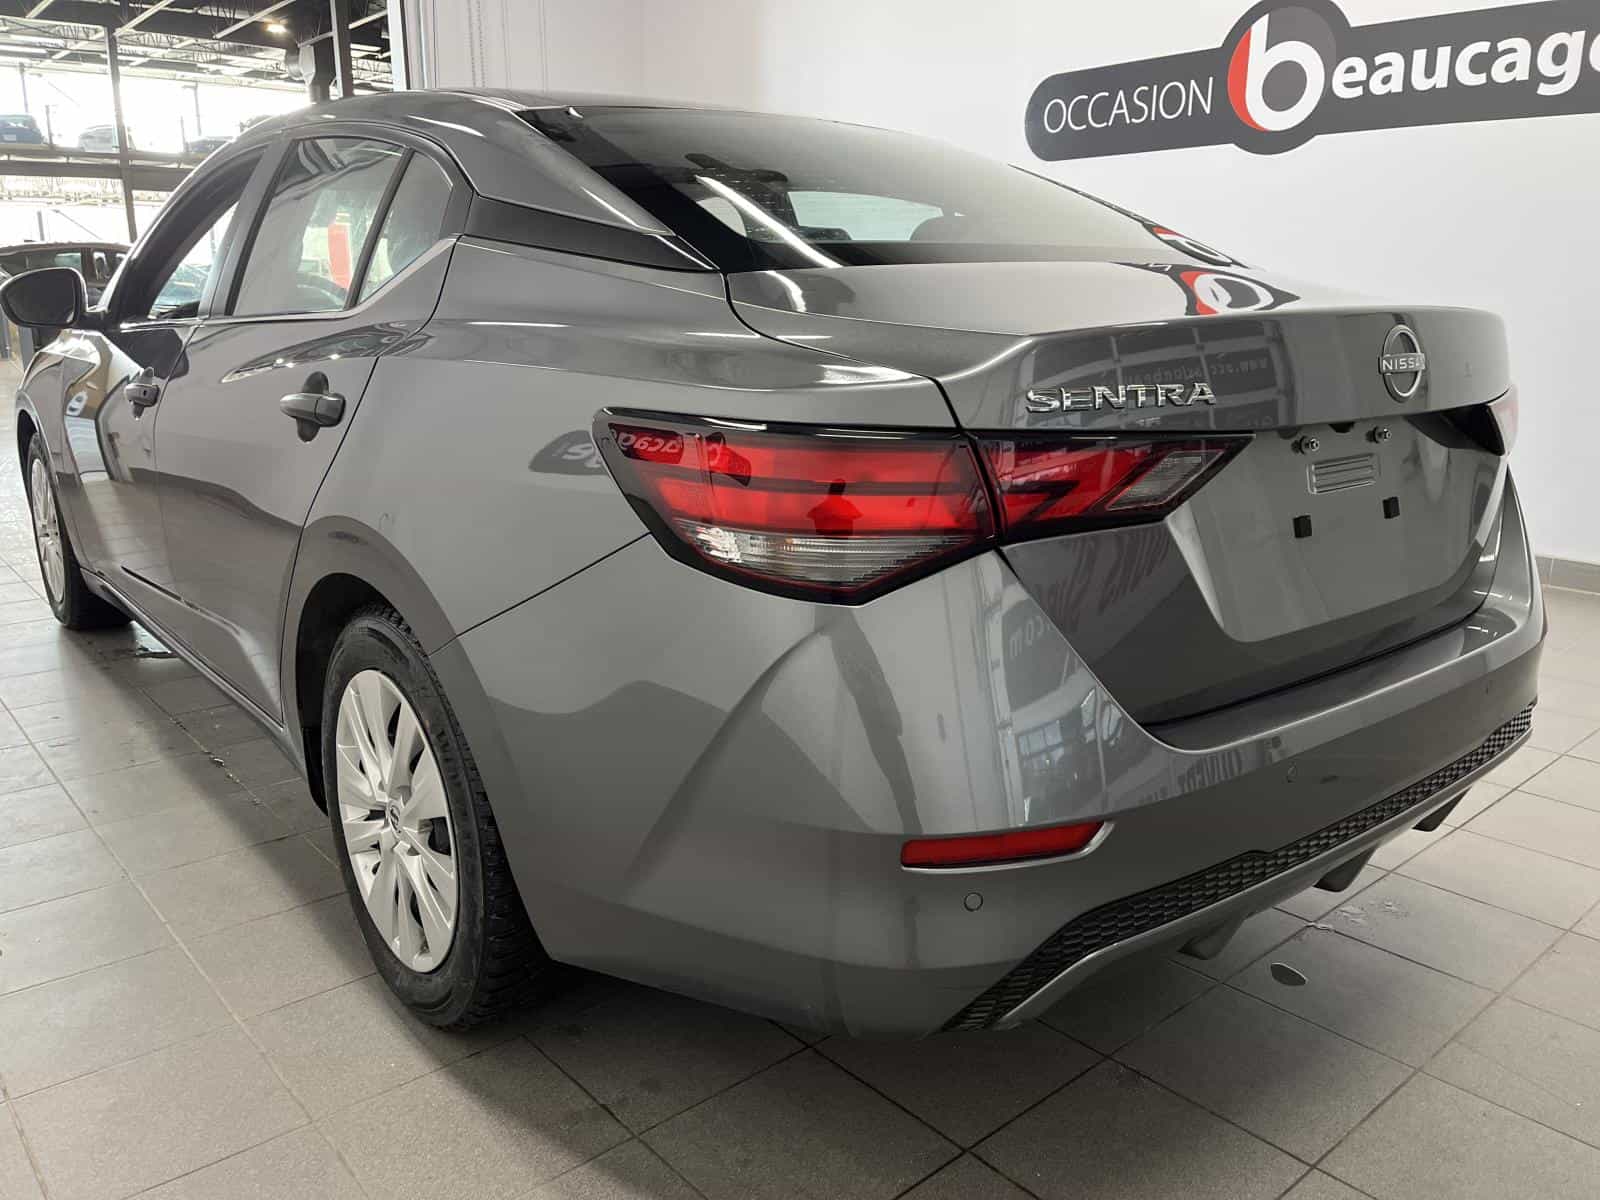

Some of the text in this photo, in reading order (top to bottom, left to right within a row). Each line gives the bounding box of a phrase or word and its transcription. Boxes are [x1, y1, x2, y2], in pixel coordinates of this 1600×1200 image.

[1043, 77, 1214, 134] OCCASION
[1382, 355, 1424, 370] NISS
[1026, 382, 1216, 412] SENTRA
